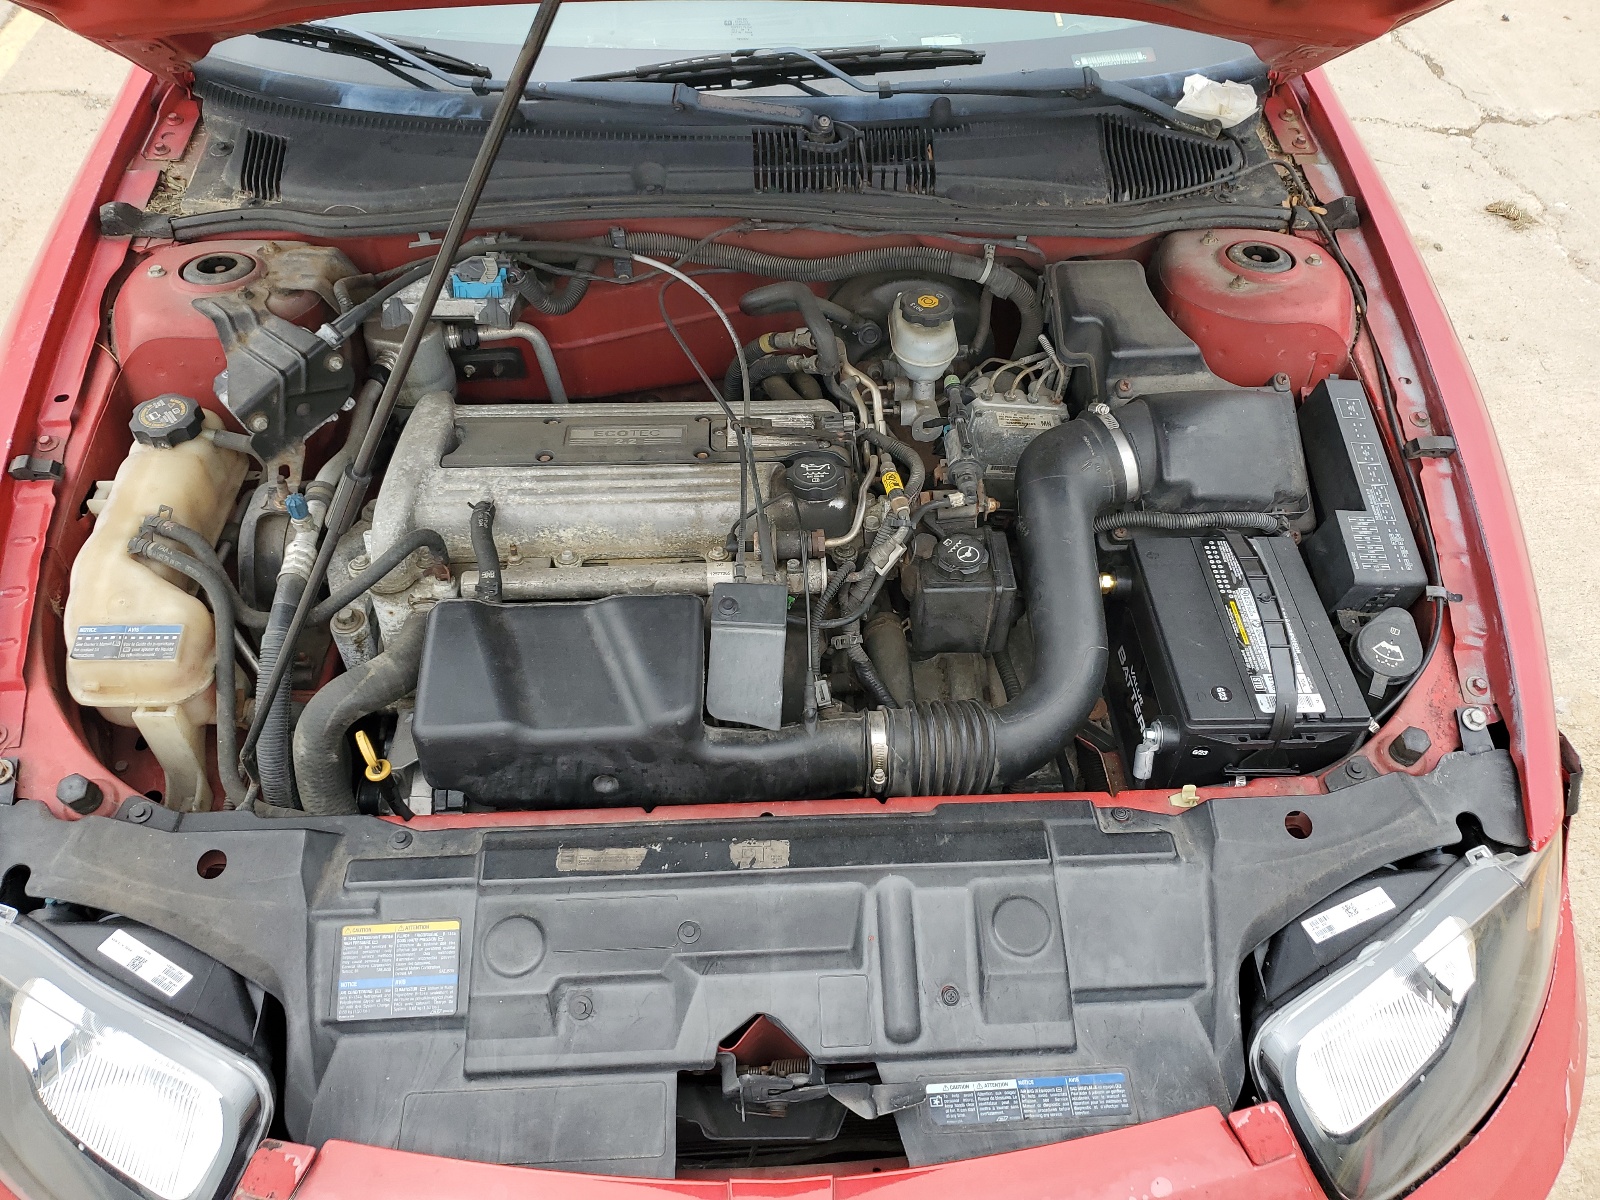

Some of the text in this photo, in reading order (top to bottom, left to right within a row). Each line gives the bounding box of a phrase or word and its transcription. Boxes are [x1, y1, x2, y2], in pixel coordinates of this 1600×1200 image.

[593, 429, 661, 437] ECOTEC
[1117, 645, 1146, 734] BATTER
[1130, 664, 1144, 706] VALUE
